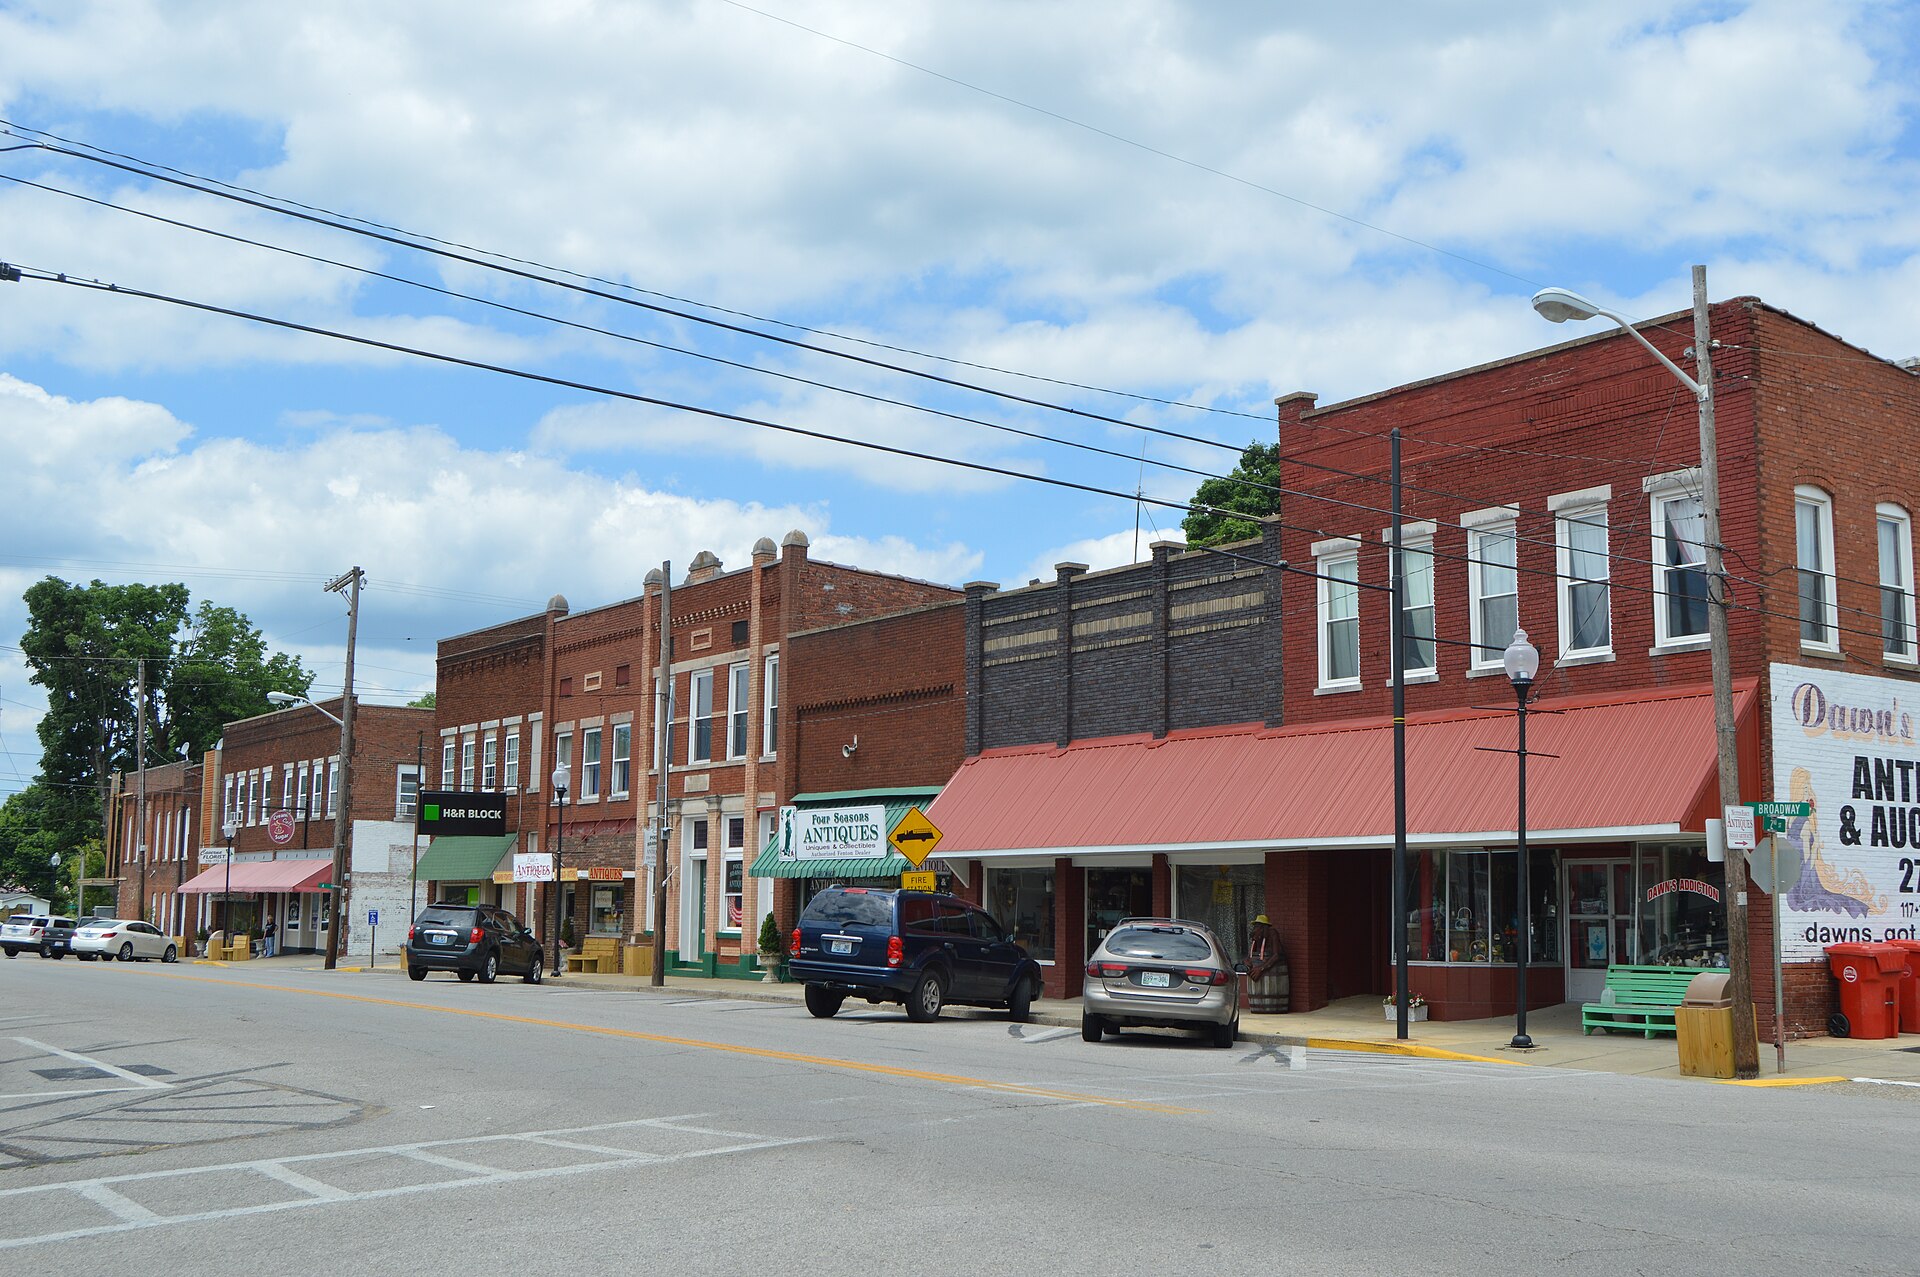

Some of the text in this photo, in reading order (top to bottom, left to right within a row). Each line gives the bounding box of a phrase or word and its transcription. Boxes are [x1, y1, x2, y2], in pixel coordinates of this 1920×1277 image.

[1791, 683, 1912, 739] Dawn's
[443, 808, 501, 819] H&R BLOCK
[1758, 803, 1800, 814] BROADWAY
[811, 812, 869, 825] Four Seasons
[1727, 813, 1753, 832] ANTIQUES
[1839, 804, 1920, 849] & AUC
[803, 824, 879, 844] ANTIQUES
[805, 844, 830, 852] Uniques
[838, 842, 876, 850] Collectibles
[515, 864, 551, 879] ANTIQUES
[589, 868, 623, 880] ANTIQUES
[911, 876, 927, 884] FIRE
[1647, 878, 1720, 903] DAWN'S ADDICTION
